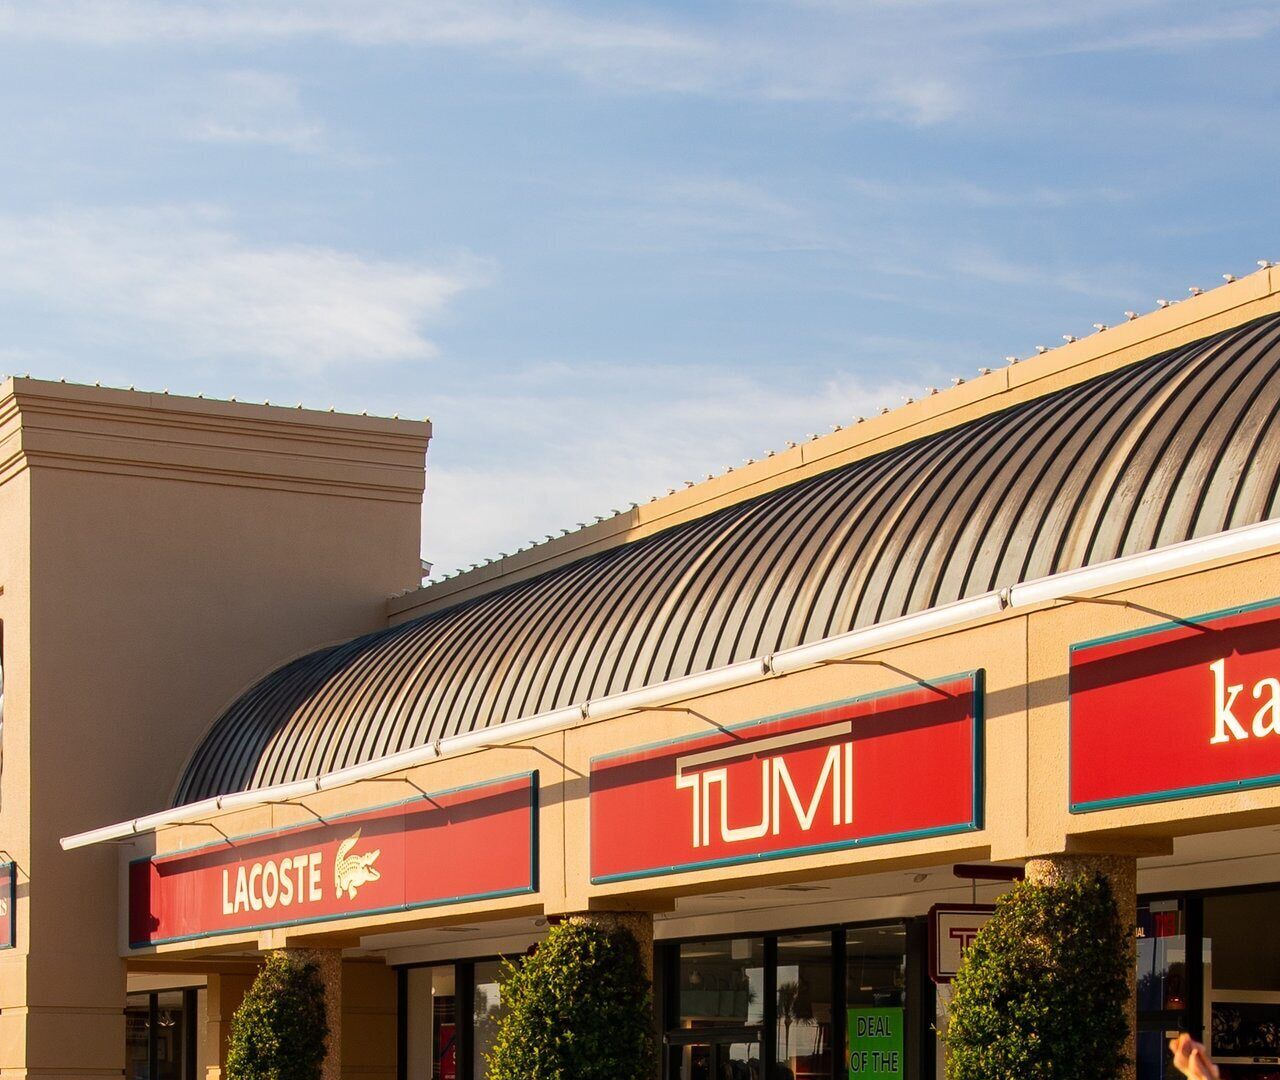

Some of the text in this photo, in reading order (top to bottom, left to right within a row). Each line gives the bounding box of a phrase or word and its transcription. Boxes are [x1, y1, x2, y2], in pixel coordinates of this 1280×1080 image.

[676, 720, 853, 849] TUMI
[222, 851, 323, 916] LACOSTE
[857, 1016, 892, 1037] DEAL
[850, 1051, 899, 1073] OF THE
